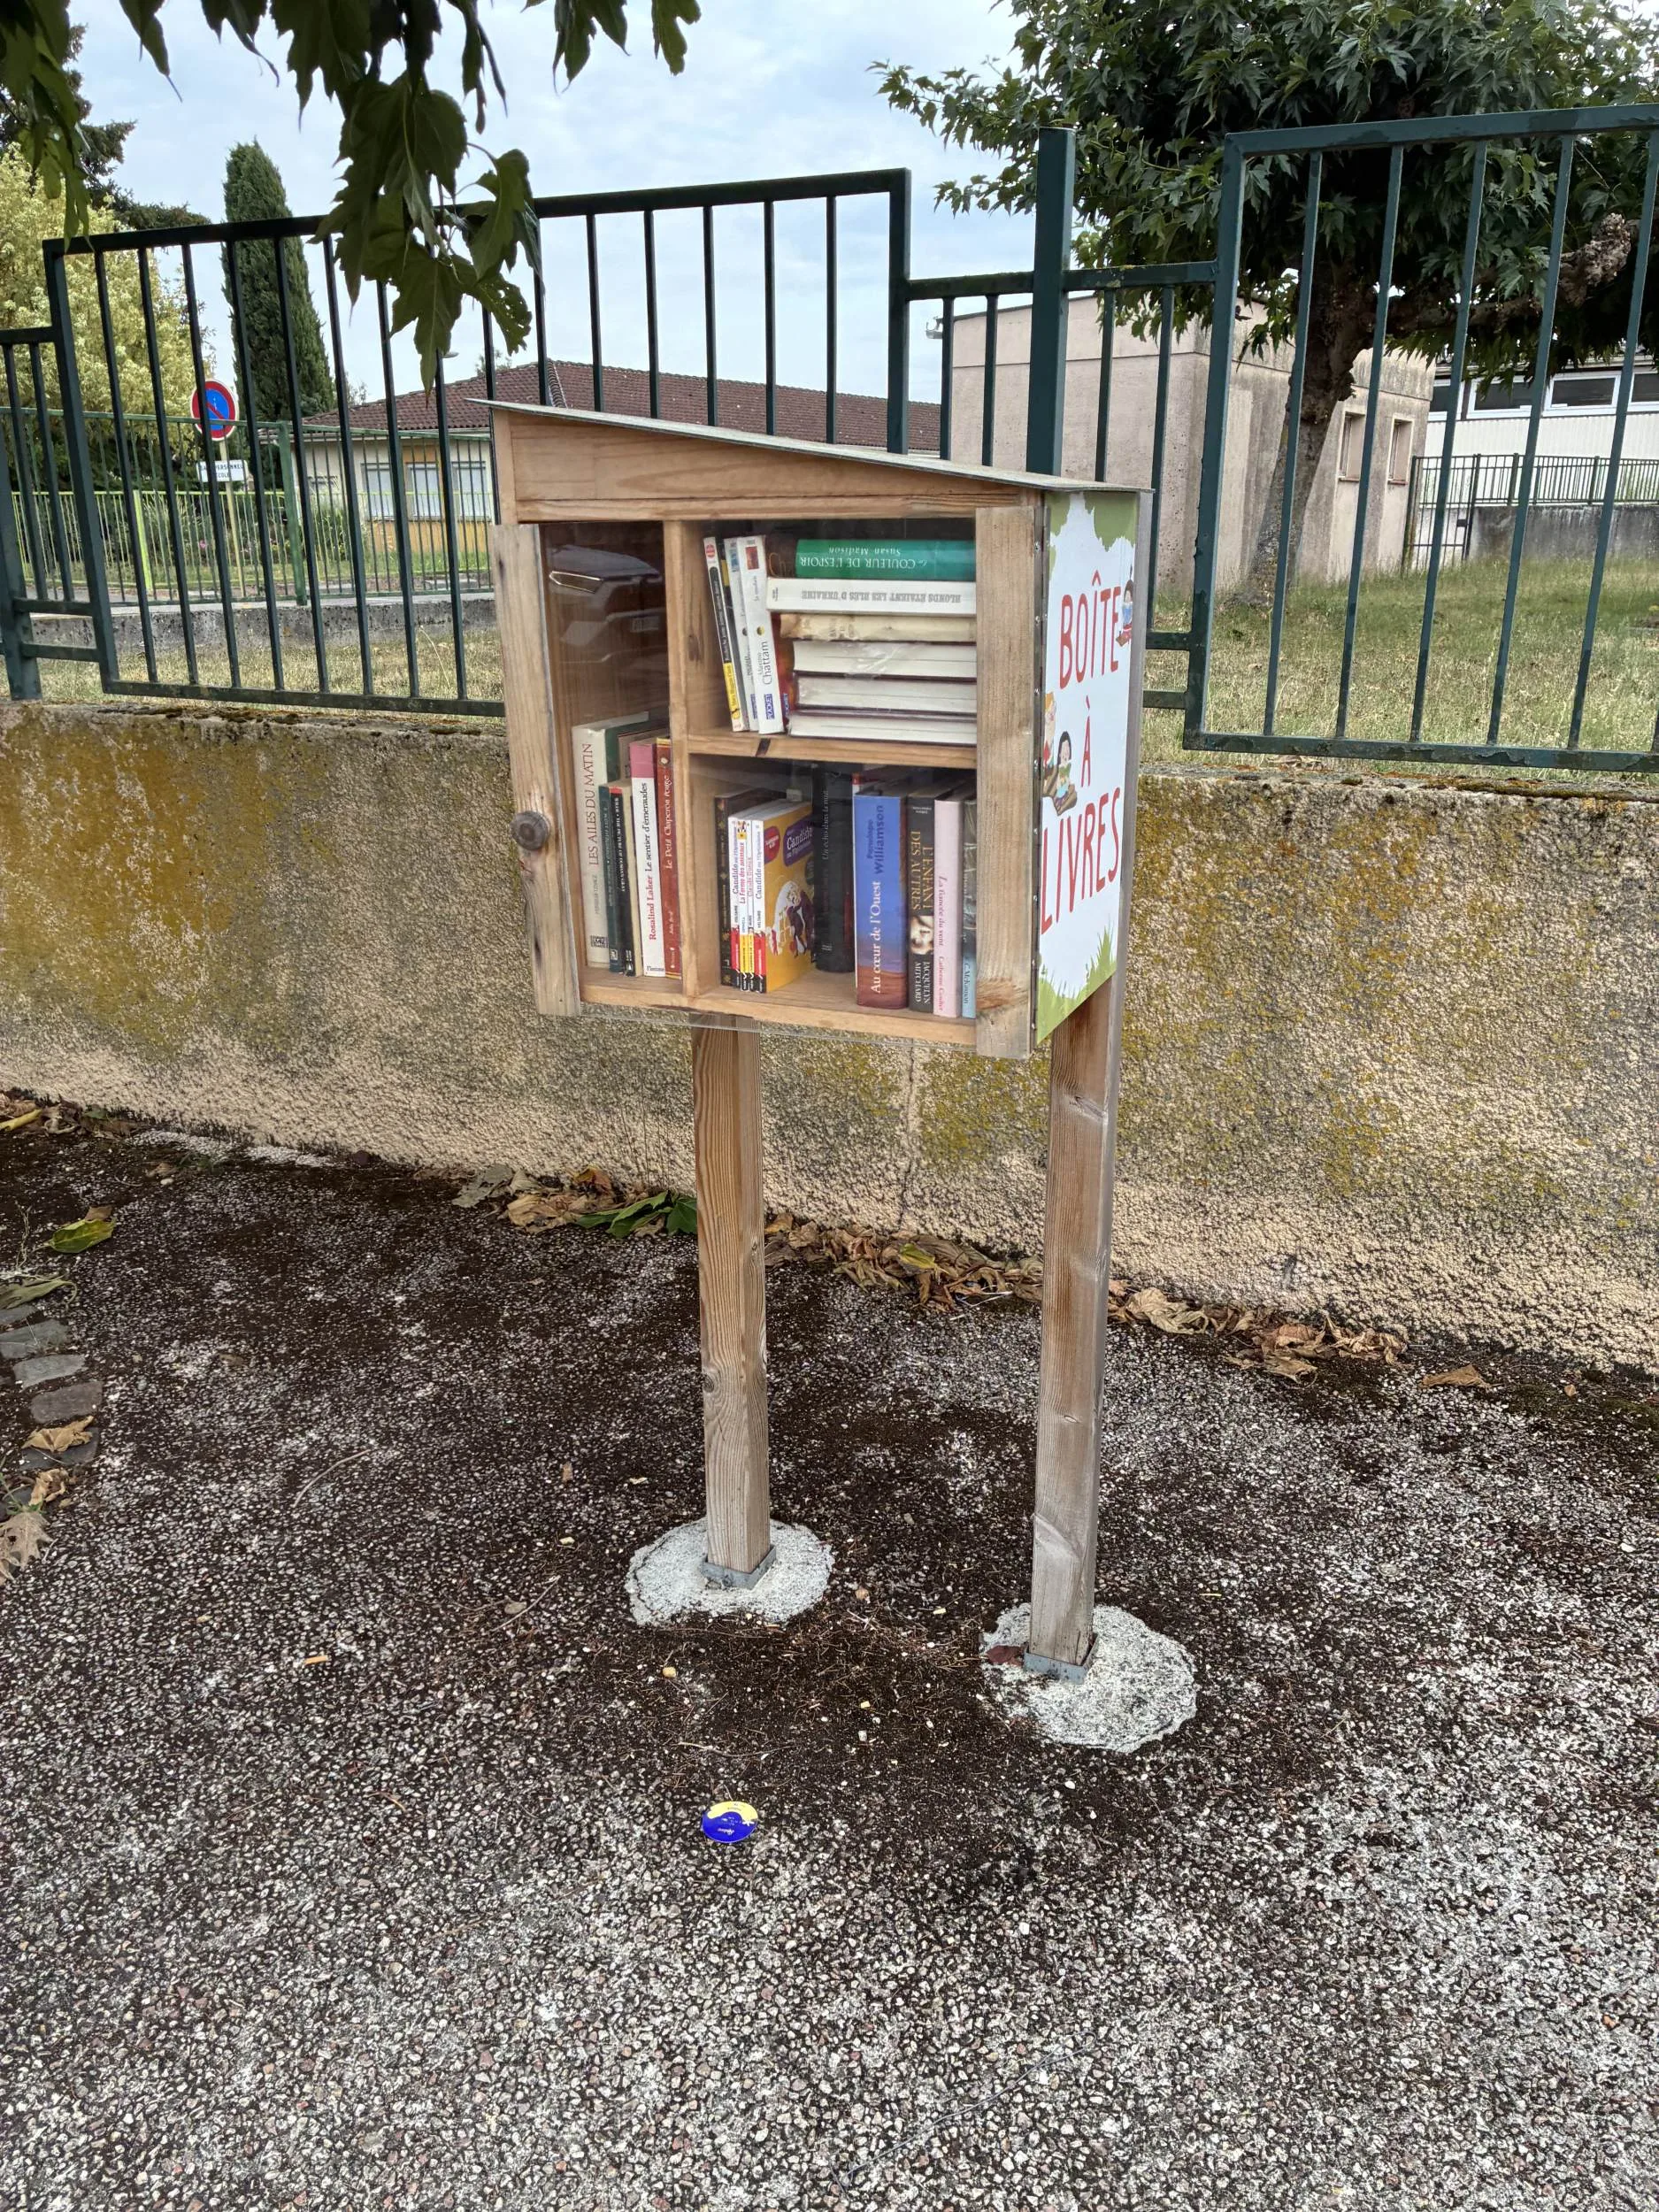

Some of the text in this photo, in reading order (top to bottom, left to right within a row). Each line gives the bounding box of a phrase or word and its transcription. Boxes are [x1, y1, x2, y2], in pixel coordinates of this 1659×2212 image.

[800, 557, 842, 567] L'ESPOIR
[828, 546, 869, 556] Madison
[847, 557, 861, 568] DE
[865, 557, 916, 569] COULEUR
[802, 590, 847, 601] D'UKRAINE
[872, 593, 887, 603] LES
[928, 594, 961, 603] BLONDS
[1059, 569, 1122, 689] BOÎTE
[758, 641, 772, 684] Chattam
[764, 693, 774, 718] POCKET
[1080, 695, 1092, 787] À
[581, 743, 598, 864] LES AILES DU MATIN
[661, 774, 673, 868] Le Petit Chaperon rouge
[873, 804, 885, 874] Williamson
[638, 783, 657, 940] Rosalind Laker Le sentier d'émeraudes
[823, 850, 828, 859] Un
[1040, 787, 1122, 935] LIVRES
[910, 831, 921, 910] DES AUTRES
[921, 846, 933, 908] L'ENFANT
[938, 876, 947, 887] La
[870, 880, 881, 923] l'Ouest
[938, 889, 947, 916] fiancée
[871, 926, 880, 941] de
[938, 918, 946, 927] du
[871, 977, 880, 993] Au
